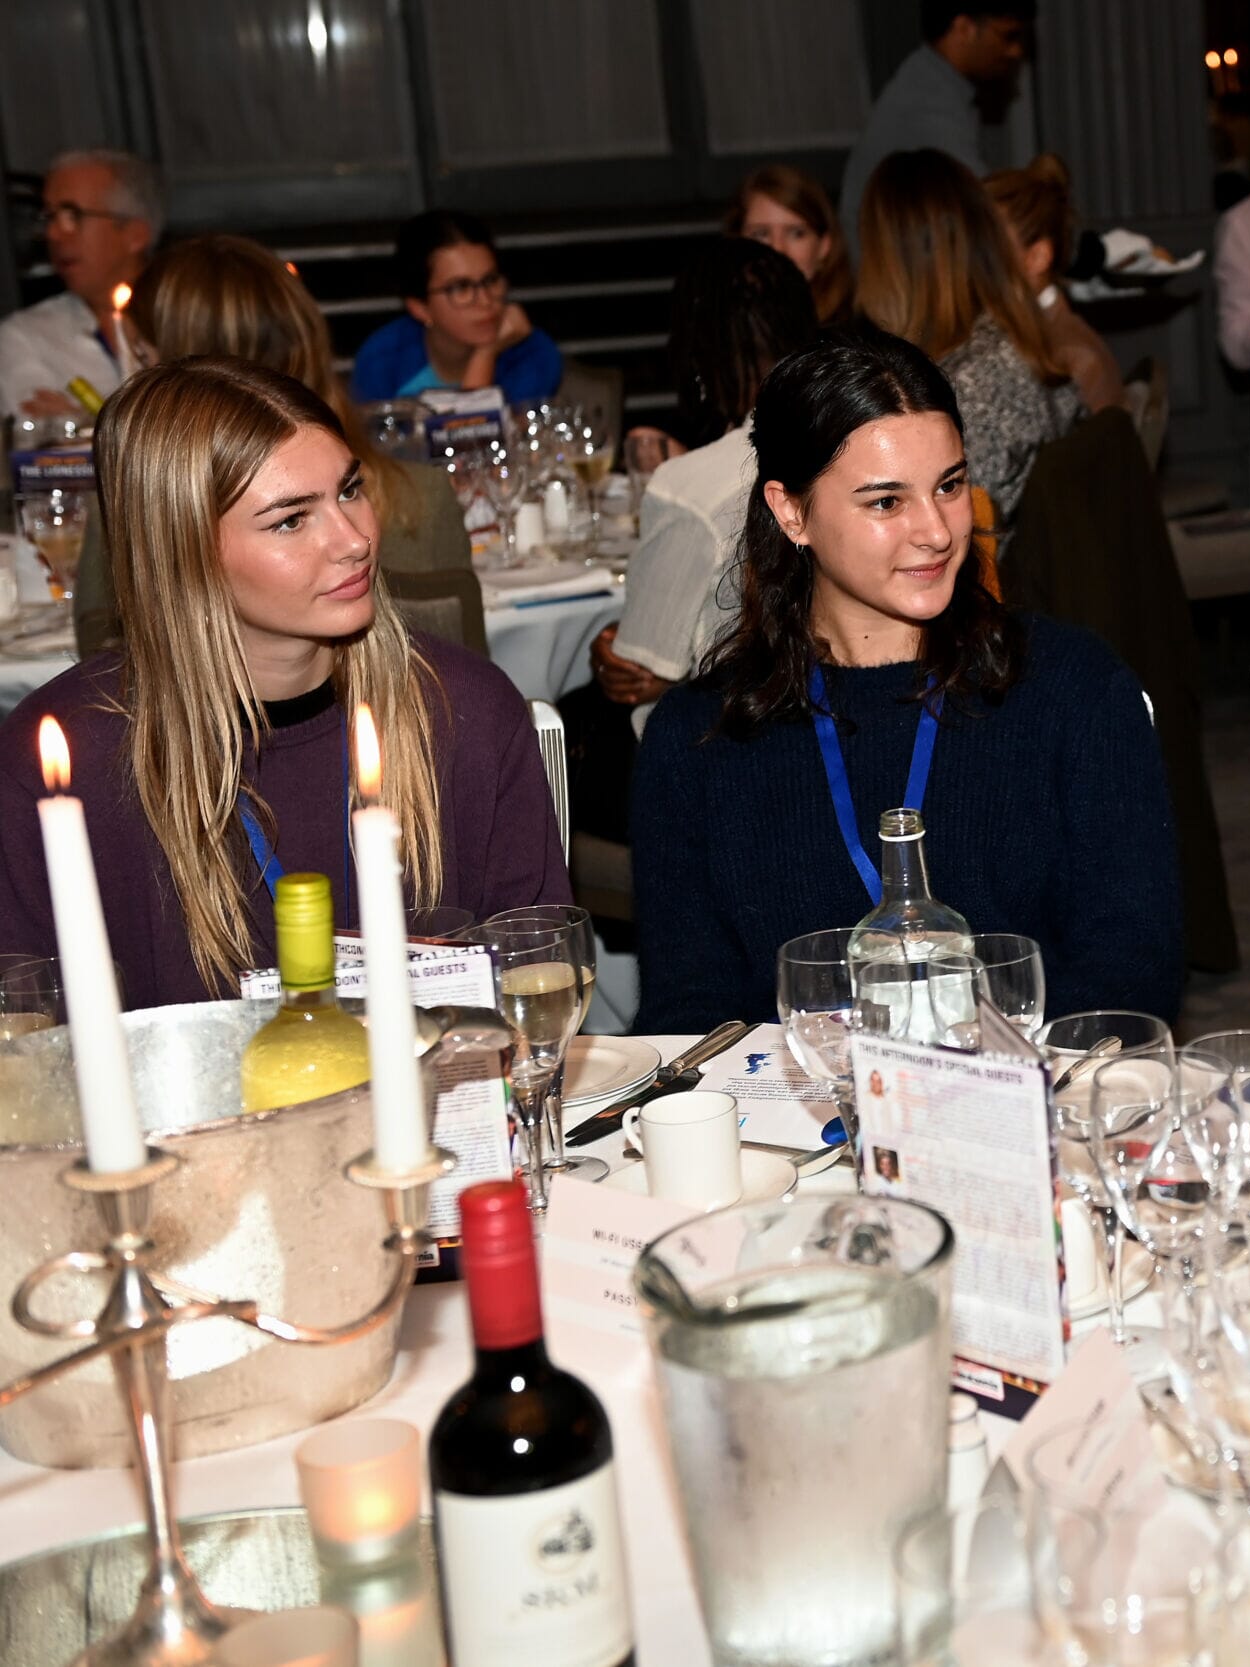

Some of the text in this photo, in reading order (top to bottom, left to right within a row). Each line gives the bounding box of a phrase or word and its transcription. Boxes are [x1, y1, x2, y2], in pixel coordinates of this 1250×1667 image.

[261, 981, 282, 995] THI
[422, 963, 467, 977] GUESTS
[858, 1042, 878, 1057] THIS
[881, 1047, 942, 1070] AFTERNOON'S
[985, 1067, 1023, 1085] GUESTS
[603, 1288, 639, 1308] PASS
